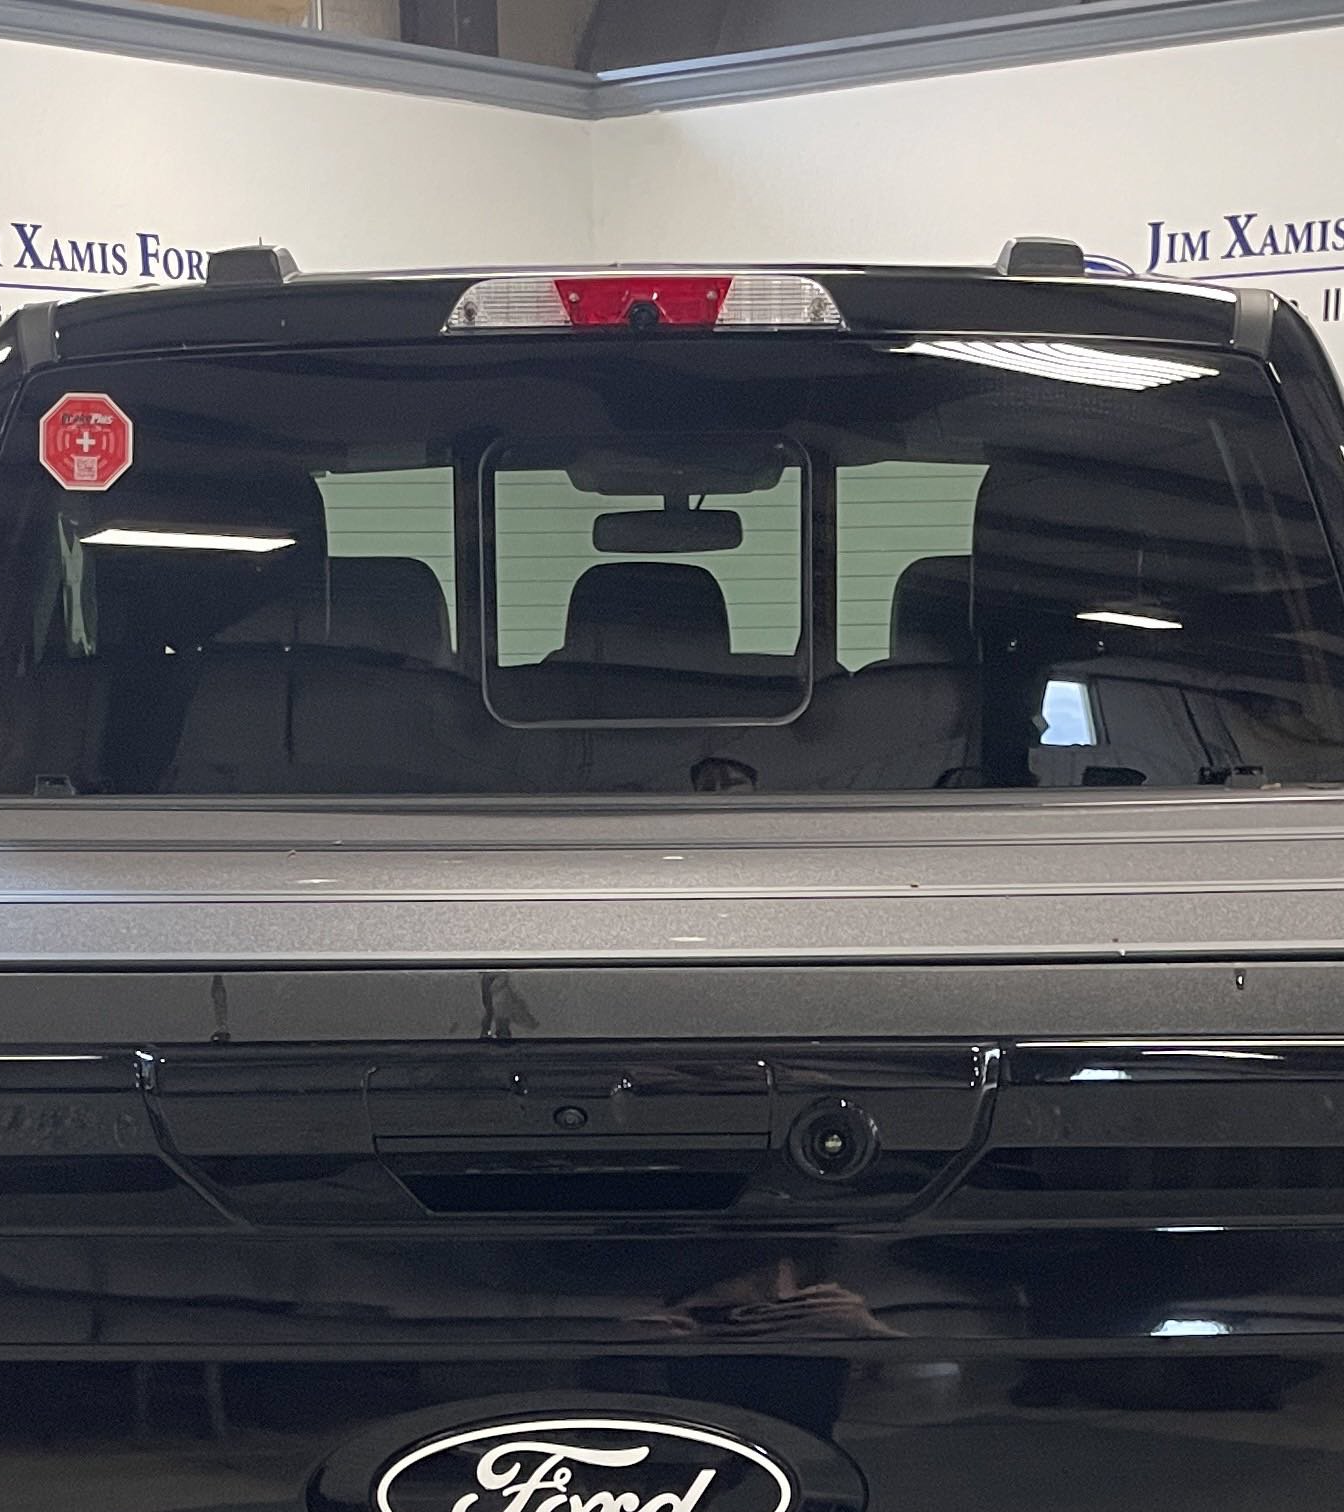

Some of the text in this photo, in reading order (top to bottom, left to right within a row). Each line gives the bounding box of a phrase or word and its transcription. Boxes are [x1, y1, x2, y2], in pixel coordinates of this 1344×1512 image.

[11, 222, 128, 276] XAMIS
[136, 232, 210, 281] FOR
[1145, 221, 1211, 274] JIM
